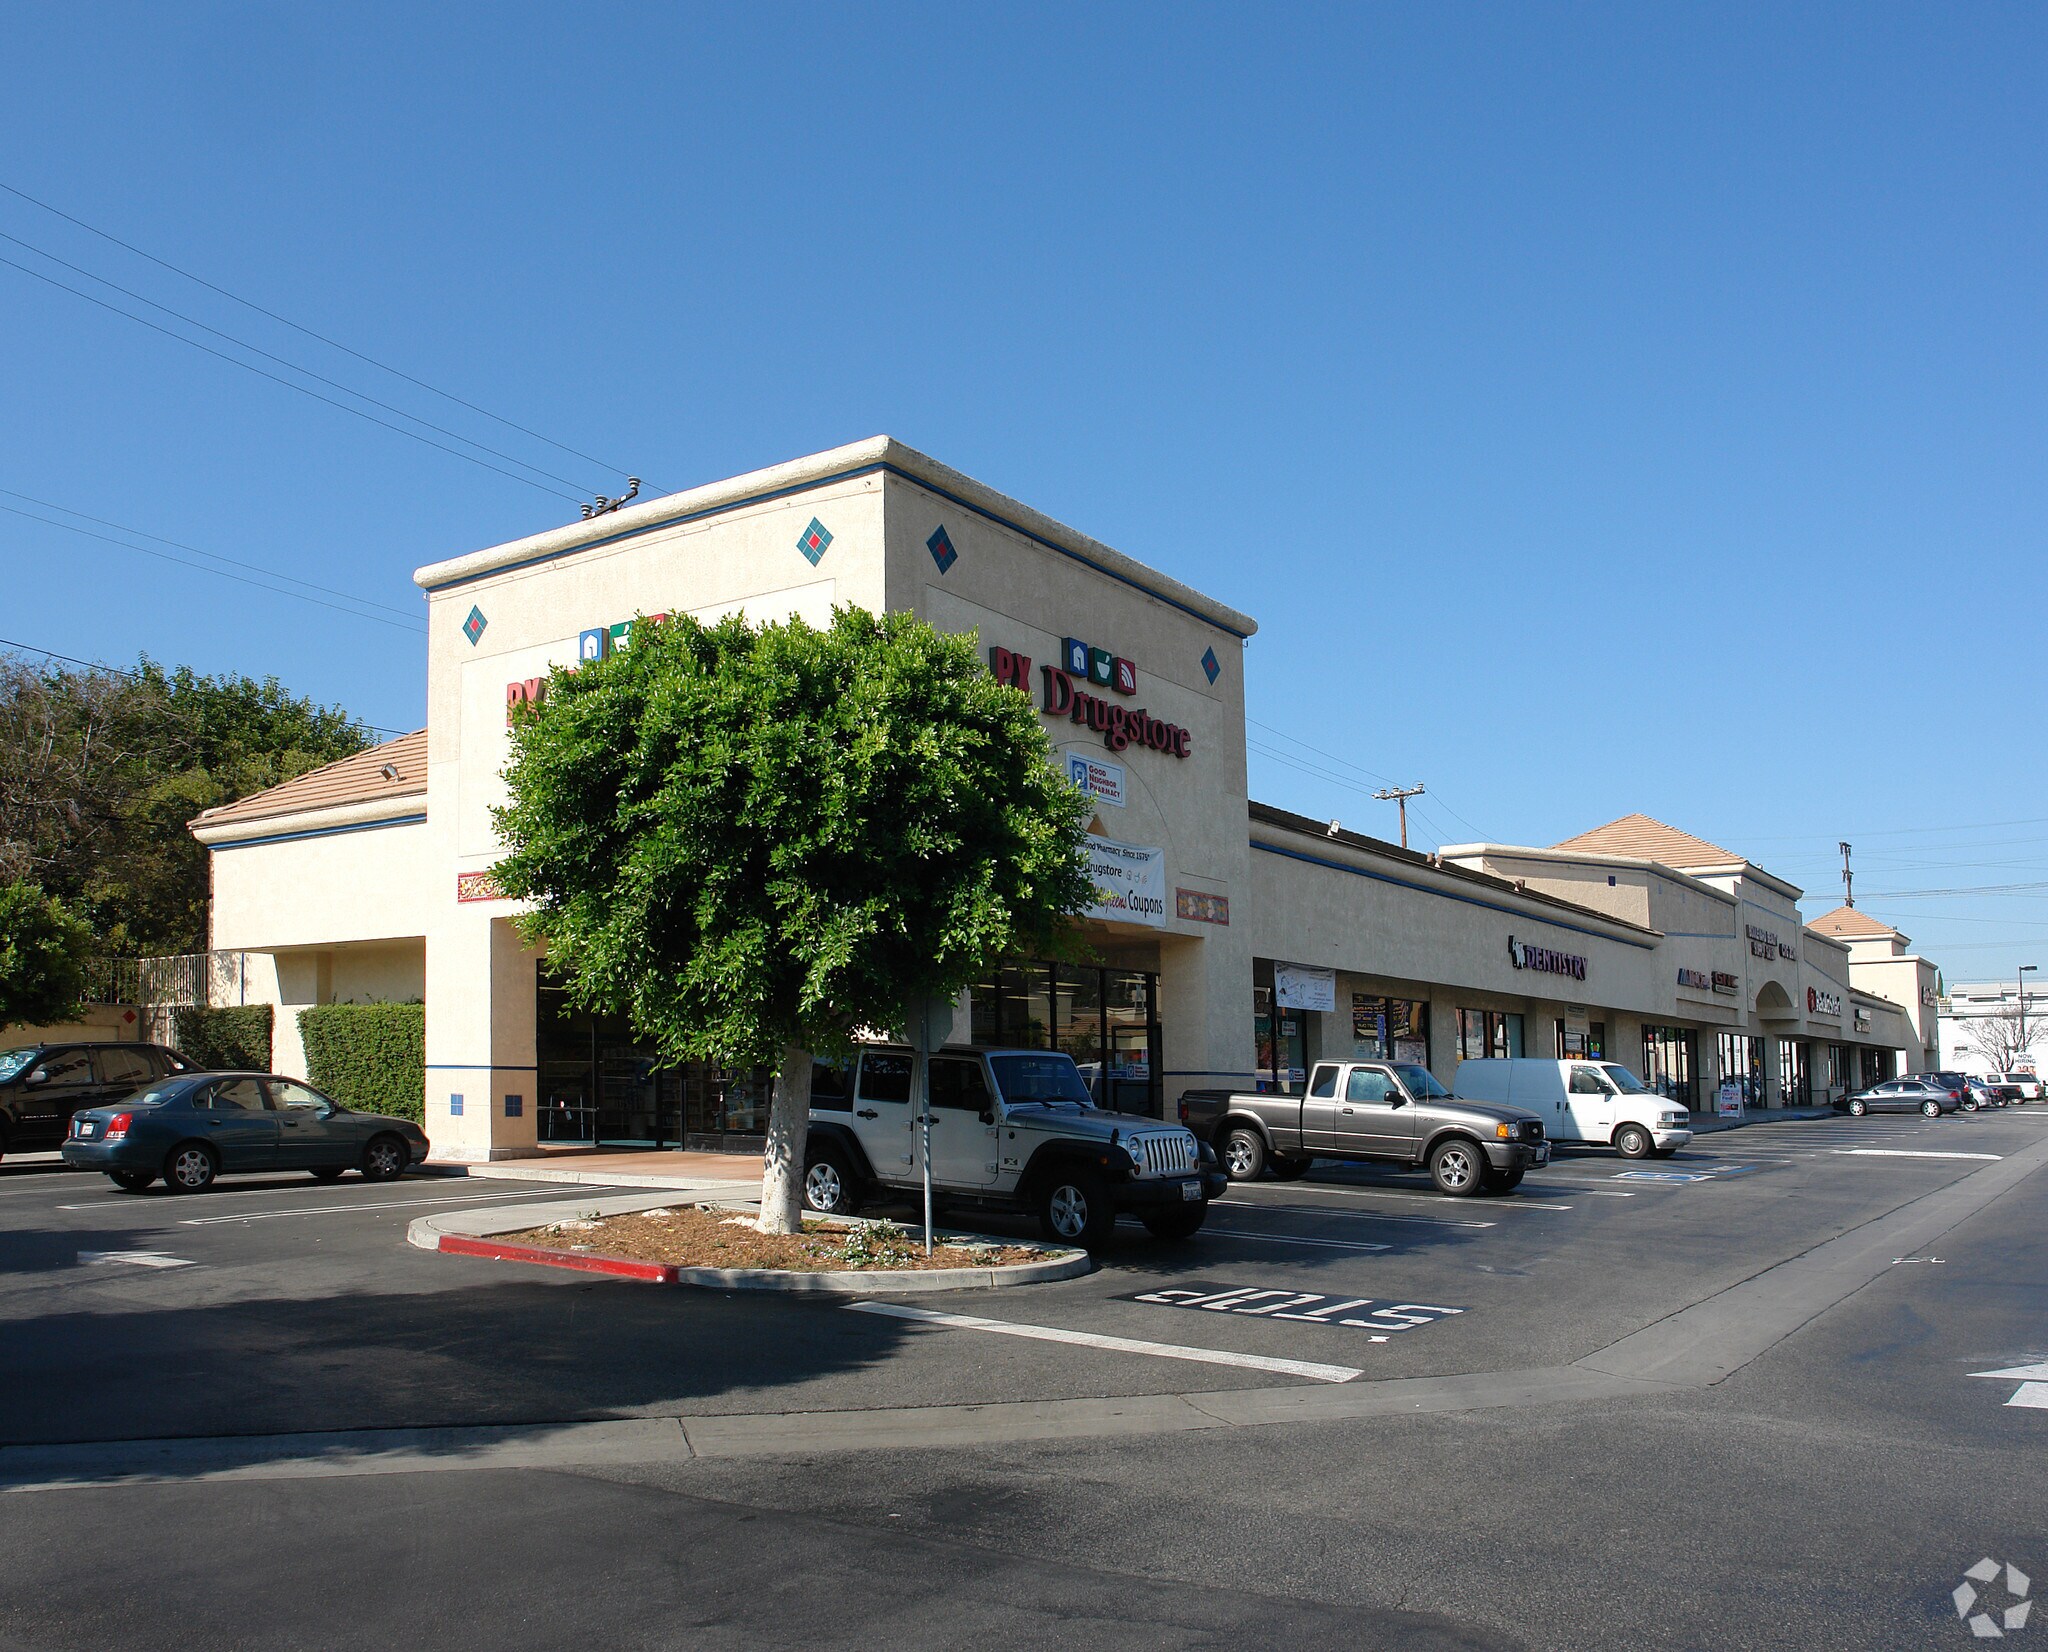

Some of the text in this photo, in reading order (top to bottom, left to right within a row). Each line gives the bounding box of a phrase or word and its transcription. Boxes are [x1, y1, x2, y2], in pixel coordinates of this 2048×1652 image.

[1040, 665, 1191, 758] Drugstore
[1088, 765, 1107, 777] GOOD
[1089, 773, 1117, 789] NEIGHBOR
[1089, 782, 1120, 798] PHARMACY
[1096, 843, 1120, 857] Pharmacy
[1122, 848, 1135, 860] Since
[1128, 889, 1163, 918] Coupons
[1524, 945, 1588, 981] DENTISTRY
